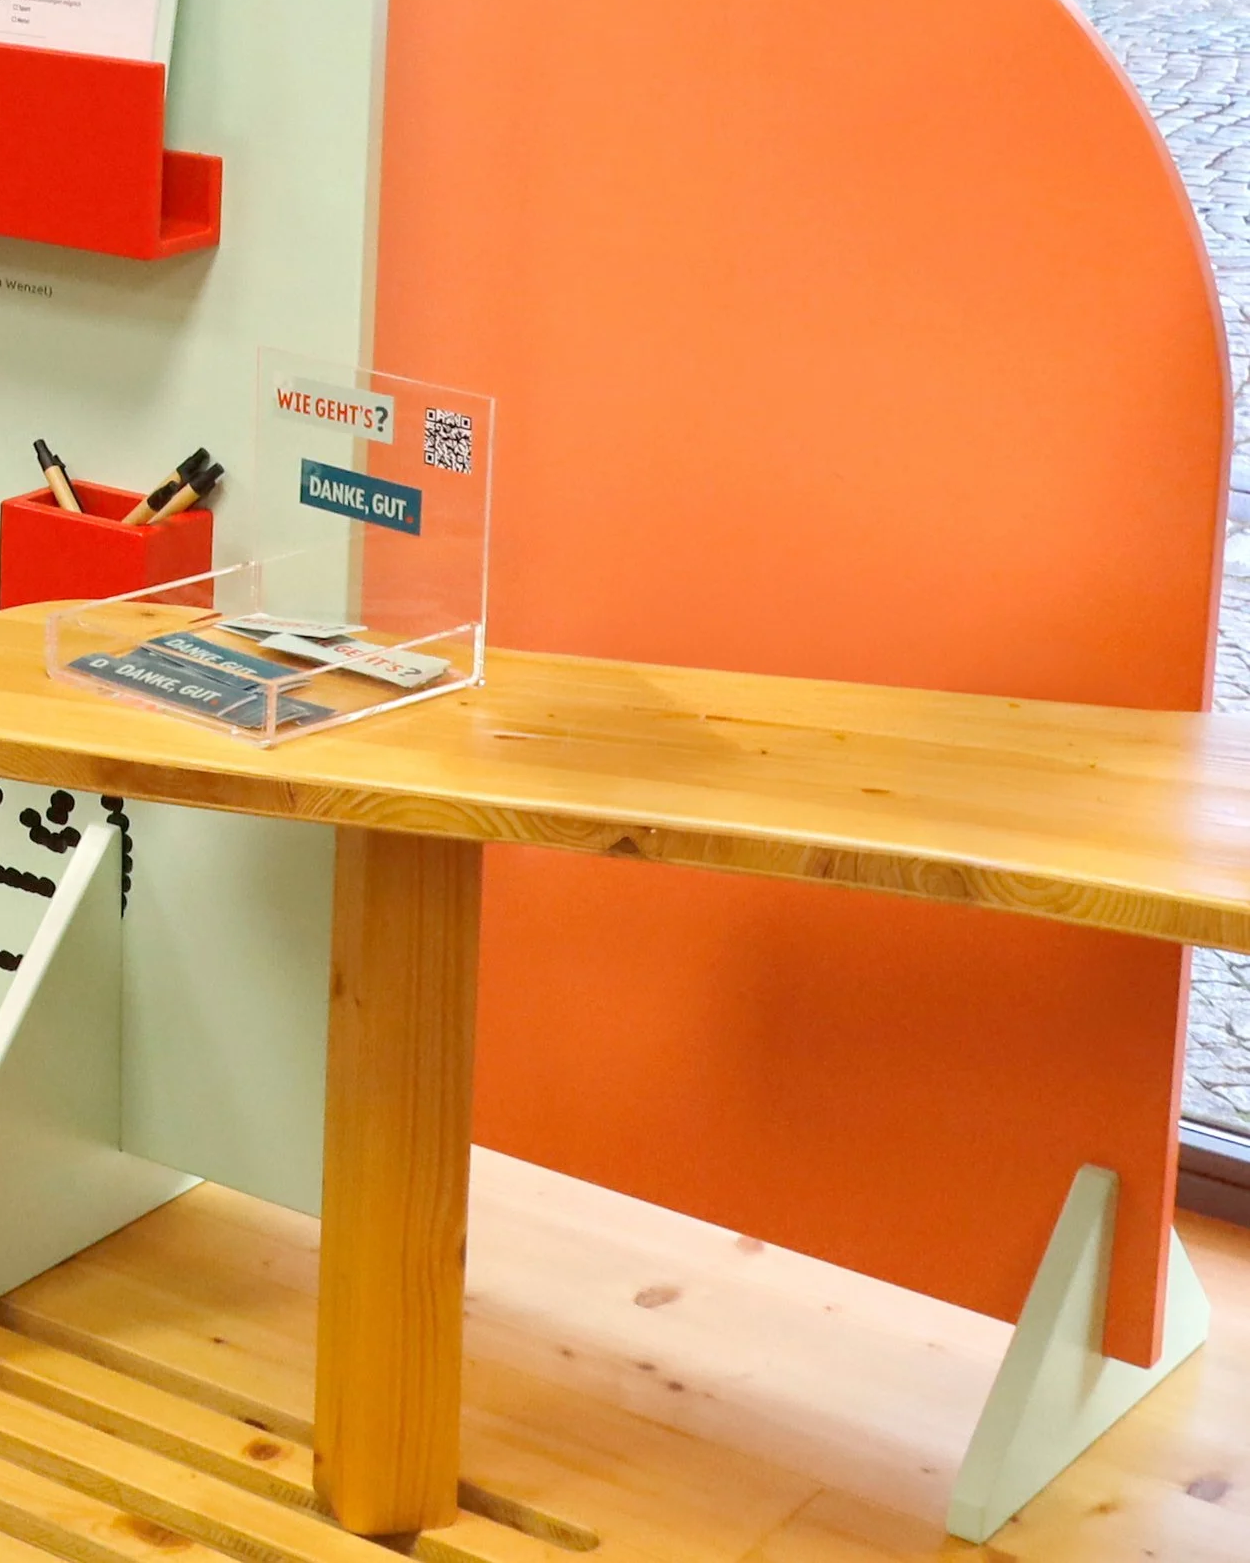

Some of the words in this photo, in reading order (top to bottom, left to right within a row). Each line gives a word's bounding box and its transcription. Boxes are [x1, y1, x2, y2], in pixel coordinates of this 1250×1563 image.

[5, 278, 53, 298] Wenzel)
[277, 388, 311, 415] WIE
[308, 474, 369, 515] DANKE,
[372, 498, 414, 524] GUT.
[220, 660, 259, 677] GUT
[115, 664, 181, 693] DANKE,
[179, 685, 223, 706] GUT.
